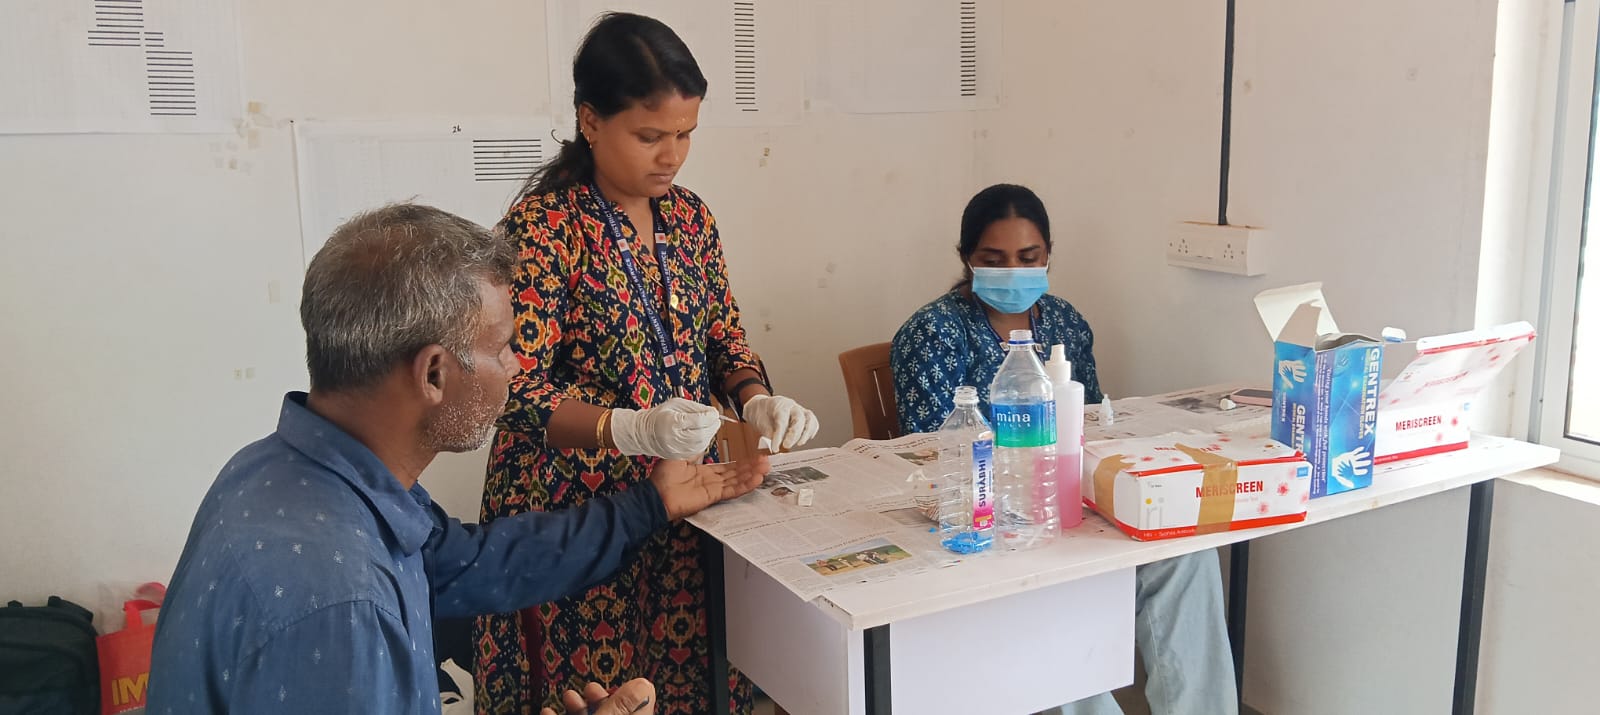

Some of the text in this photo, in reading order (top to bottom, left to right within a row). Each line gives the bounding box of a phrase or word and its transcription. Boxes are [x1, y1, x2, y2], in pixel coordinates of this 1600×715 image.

[604, 210, 621, 238] DISTRICT
[625, 258, 639, 283] SERVICE
[638, 283, 650, 306] HEALTH
[650, 315, 669, 354] DEPARTMENT
[1364, 347, 1380, 436] GENTREX
[997, 411, 1031, 422] mina
[1395, 416, 1442, 432] MERISCREEN
[1195, 480, 1264, 498] MERISCREEN
